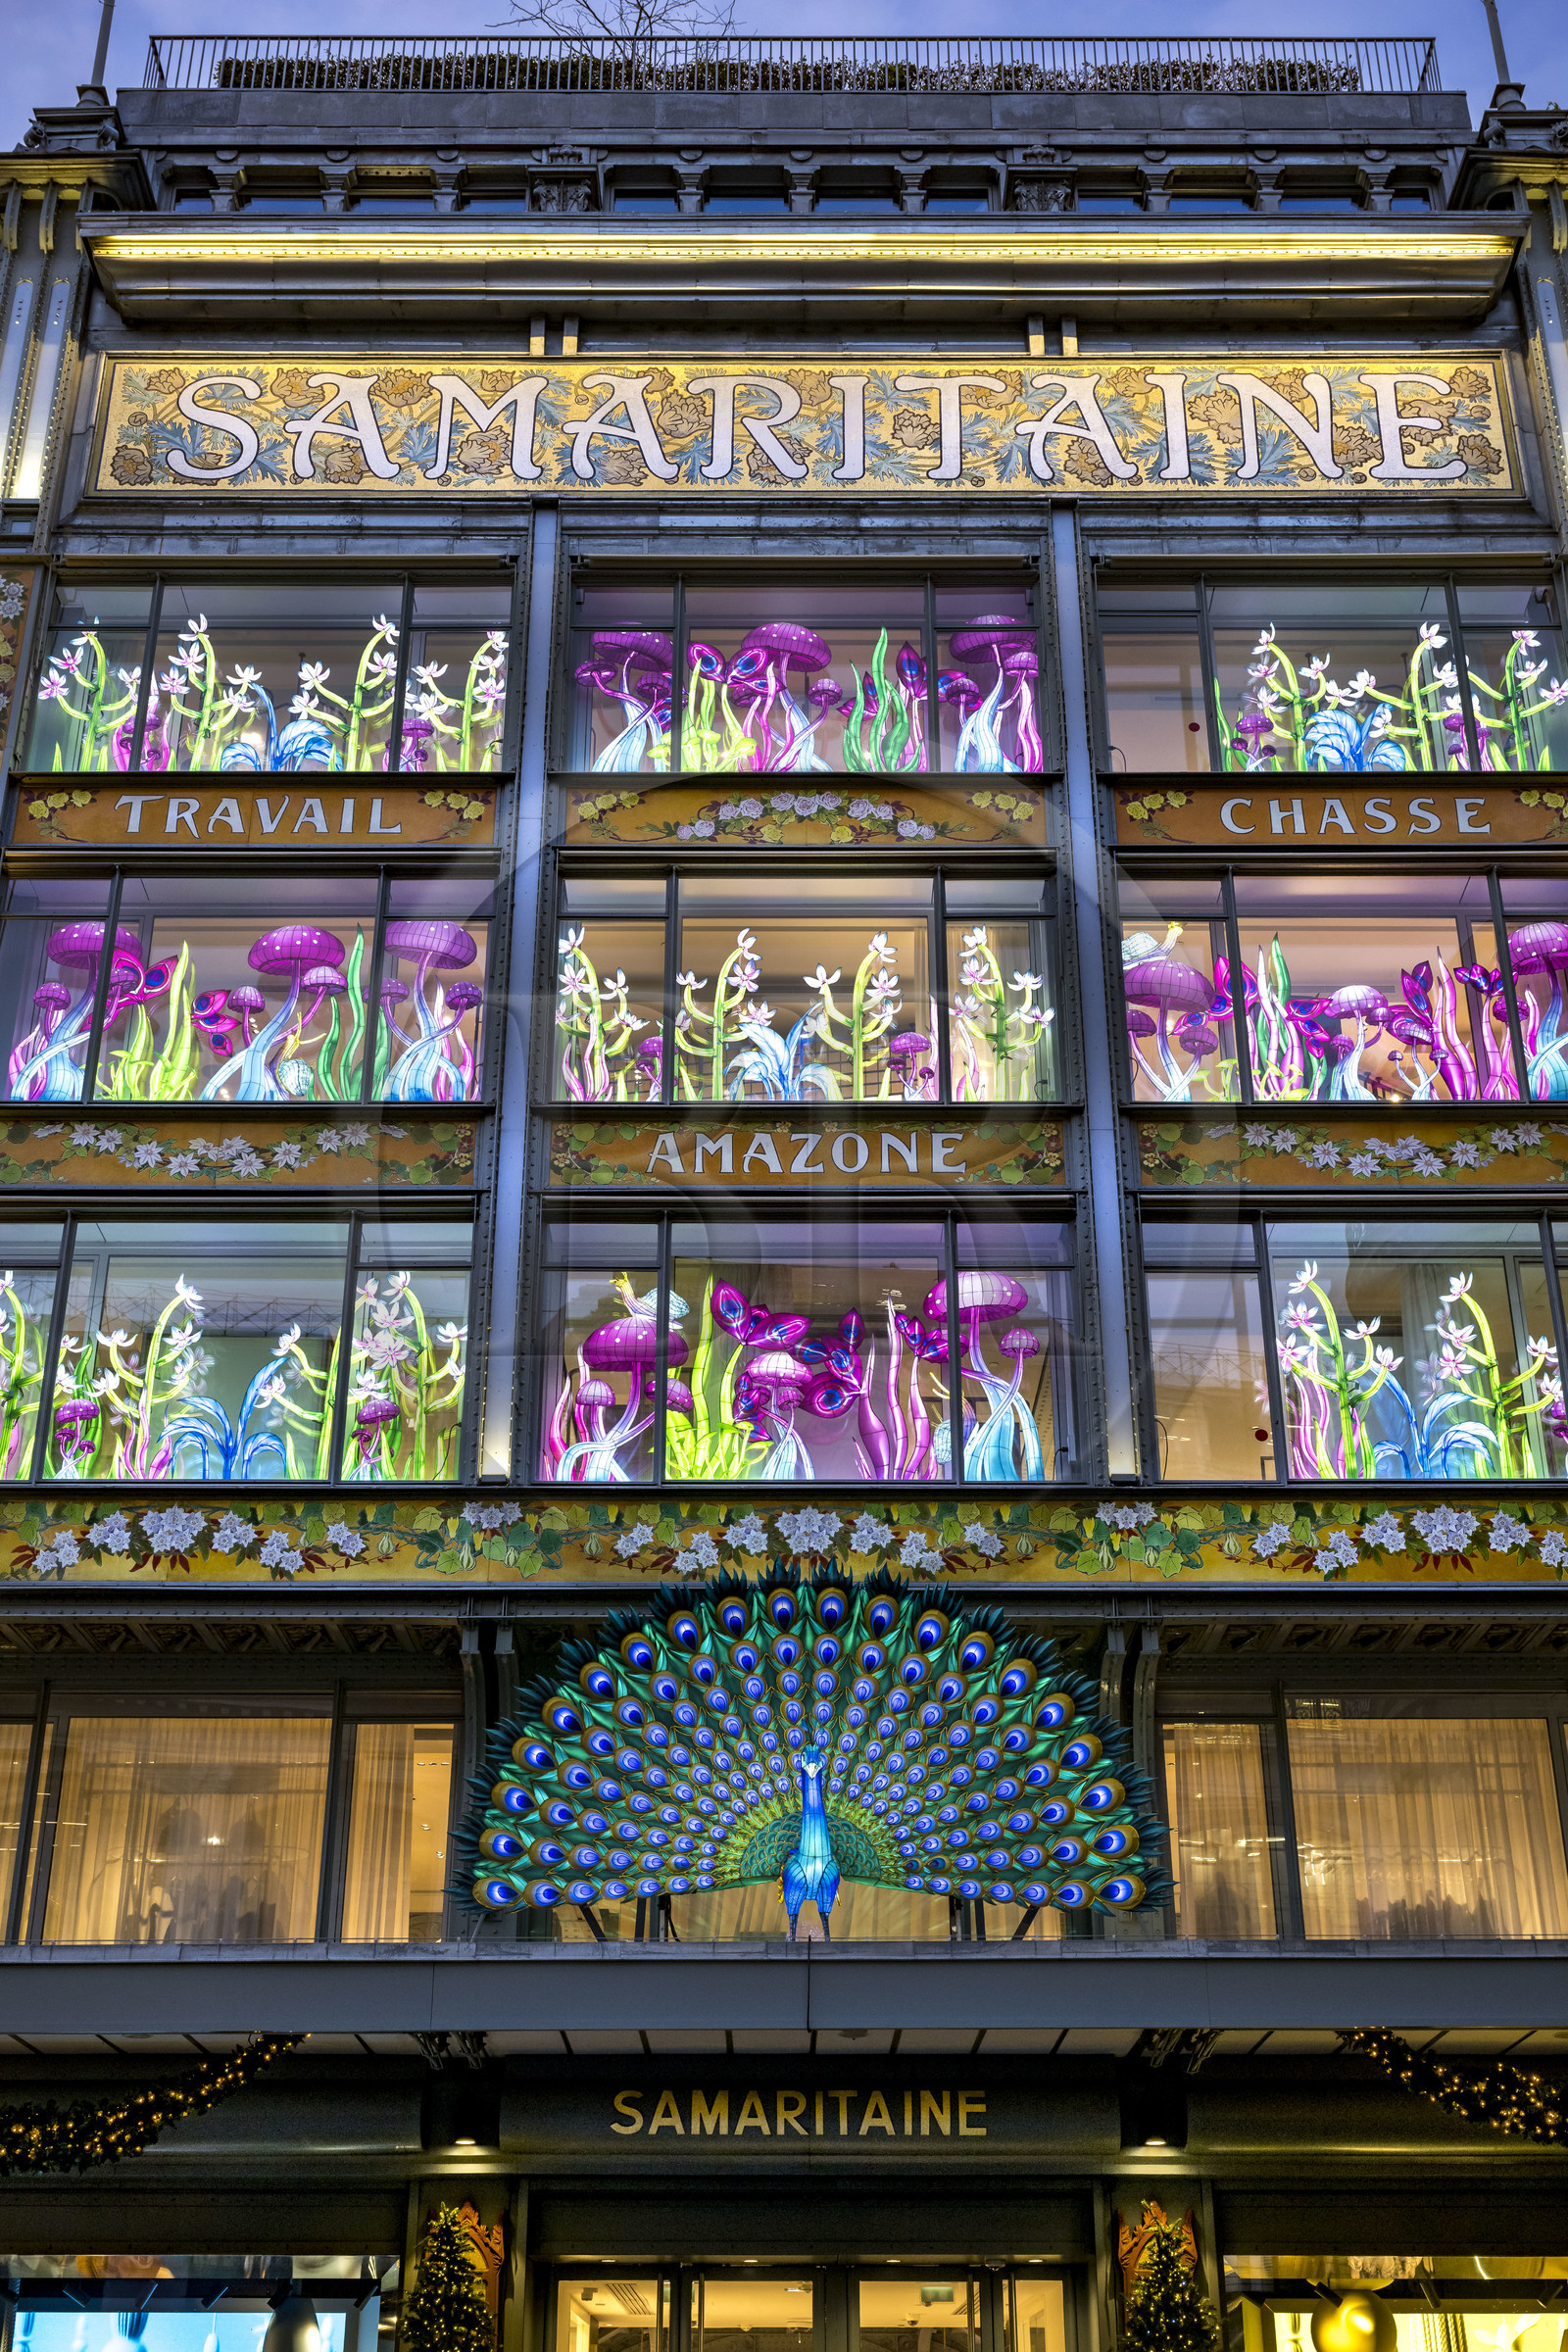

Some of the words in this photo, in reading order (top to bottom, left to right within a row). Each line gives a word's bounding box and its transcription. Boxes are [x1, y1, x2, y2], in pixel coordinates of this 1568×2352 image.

[167, 372, 1468, 480] SAMARITAINE
[115, 795, 402, 839] TRAVAIL
[1219, 798, 1492, 836] CHASSE
[645, 1132, 967, 1174] AMAZONE
[610, 2089, 988, 2135] SAMARITAINE
